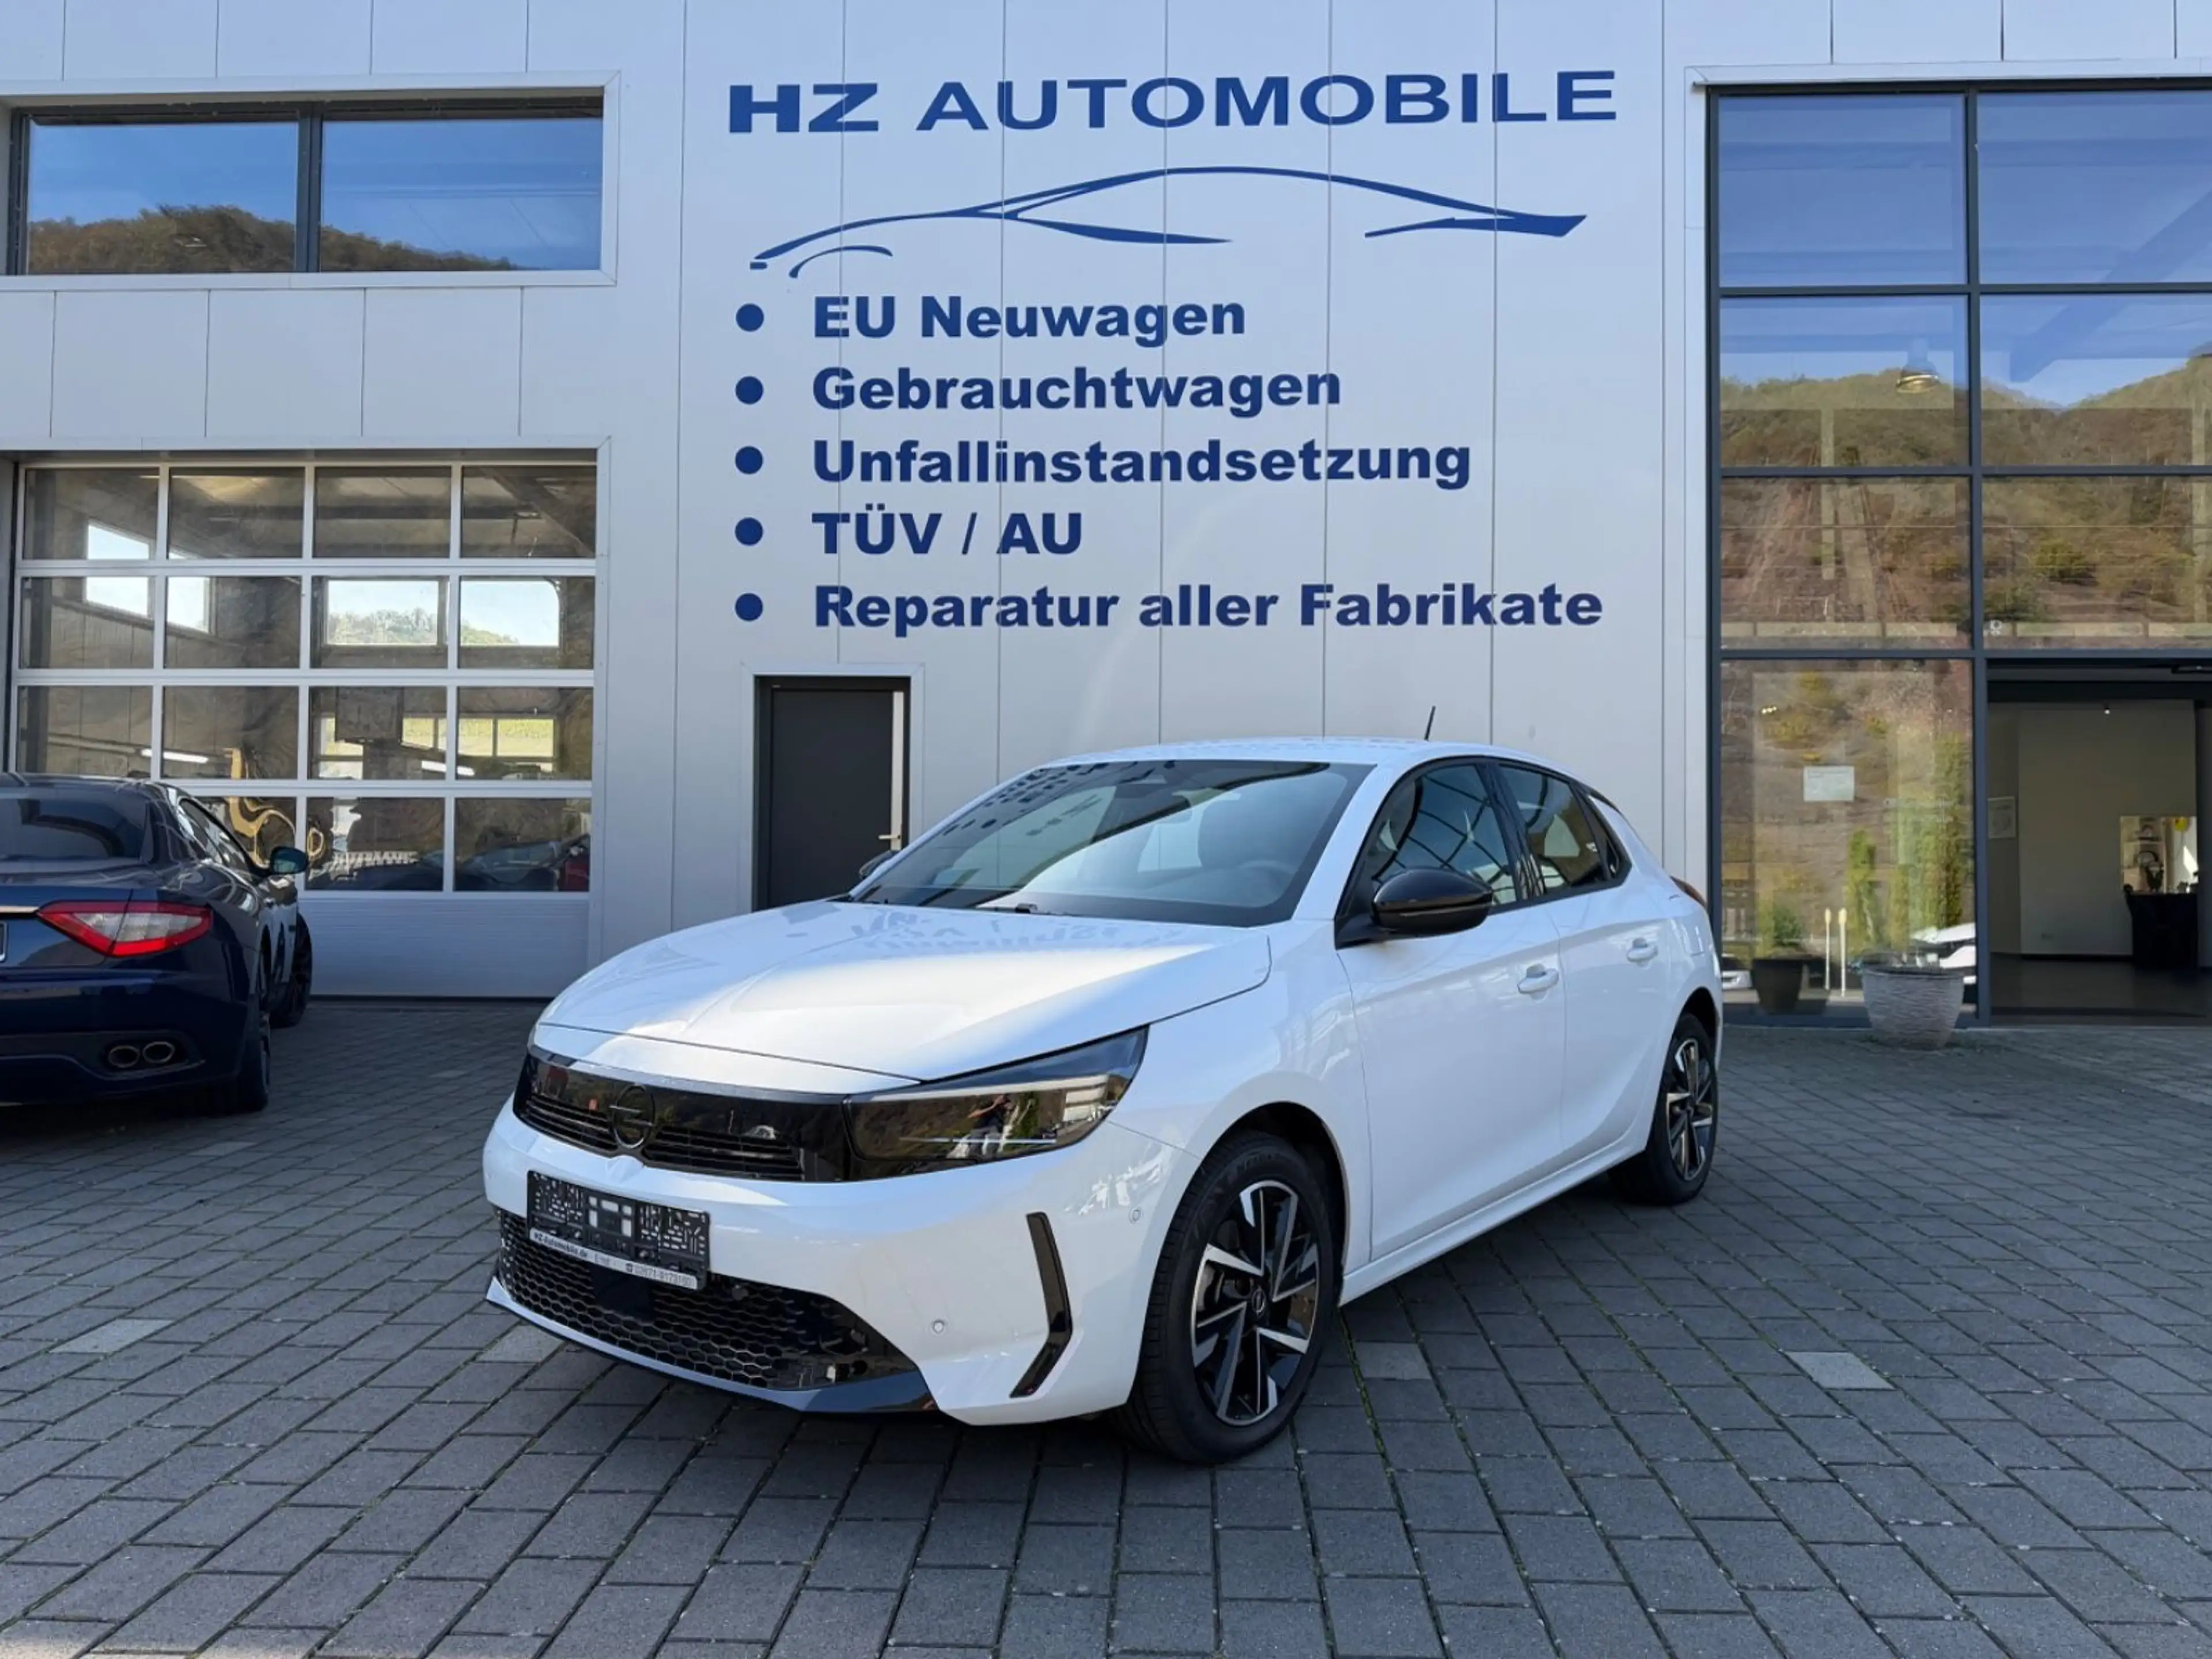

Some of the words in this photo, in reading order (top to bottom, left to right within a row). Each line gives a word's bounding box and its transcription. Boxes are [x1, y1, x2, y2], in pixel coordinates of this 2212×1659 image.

[729, 82, 878, 133] HZ
[915, 70, 1616, 130] AUTOMOBILE
[815, 296, 895, 338] EU
[921, 296, 1244, 347] Neuwagen
[813, 366, 1339, 418] Gebrauchtwagen
[814, 439, 1469, 490] Unfallinstandsetzung
[812, 503, 942, 554] TÜV
[961, 513, 977, 555] /
[997, 513, 1082, 554] AU
[816, 586, 1119, 637] Reparatur
[1141, 585, 1278, 626] aller
[1301, 584, 1601, 625] Fabrikate
